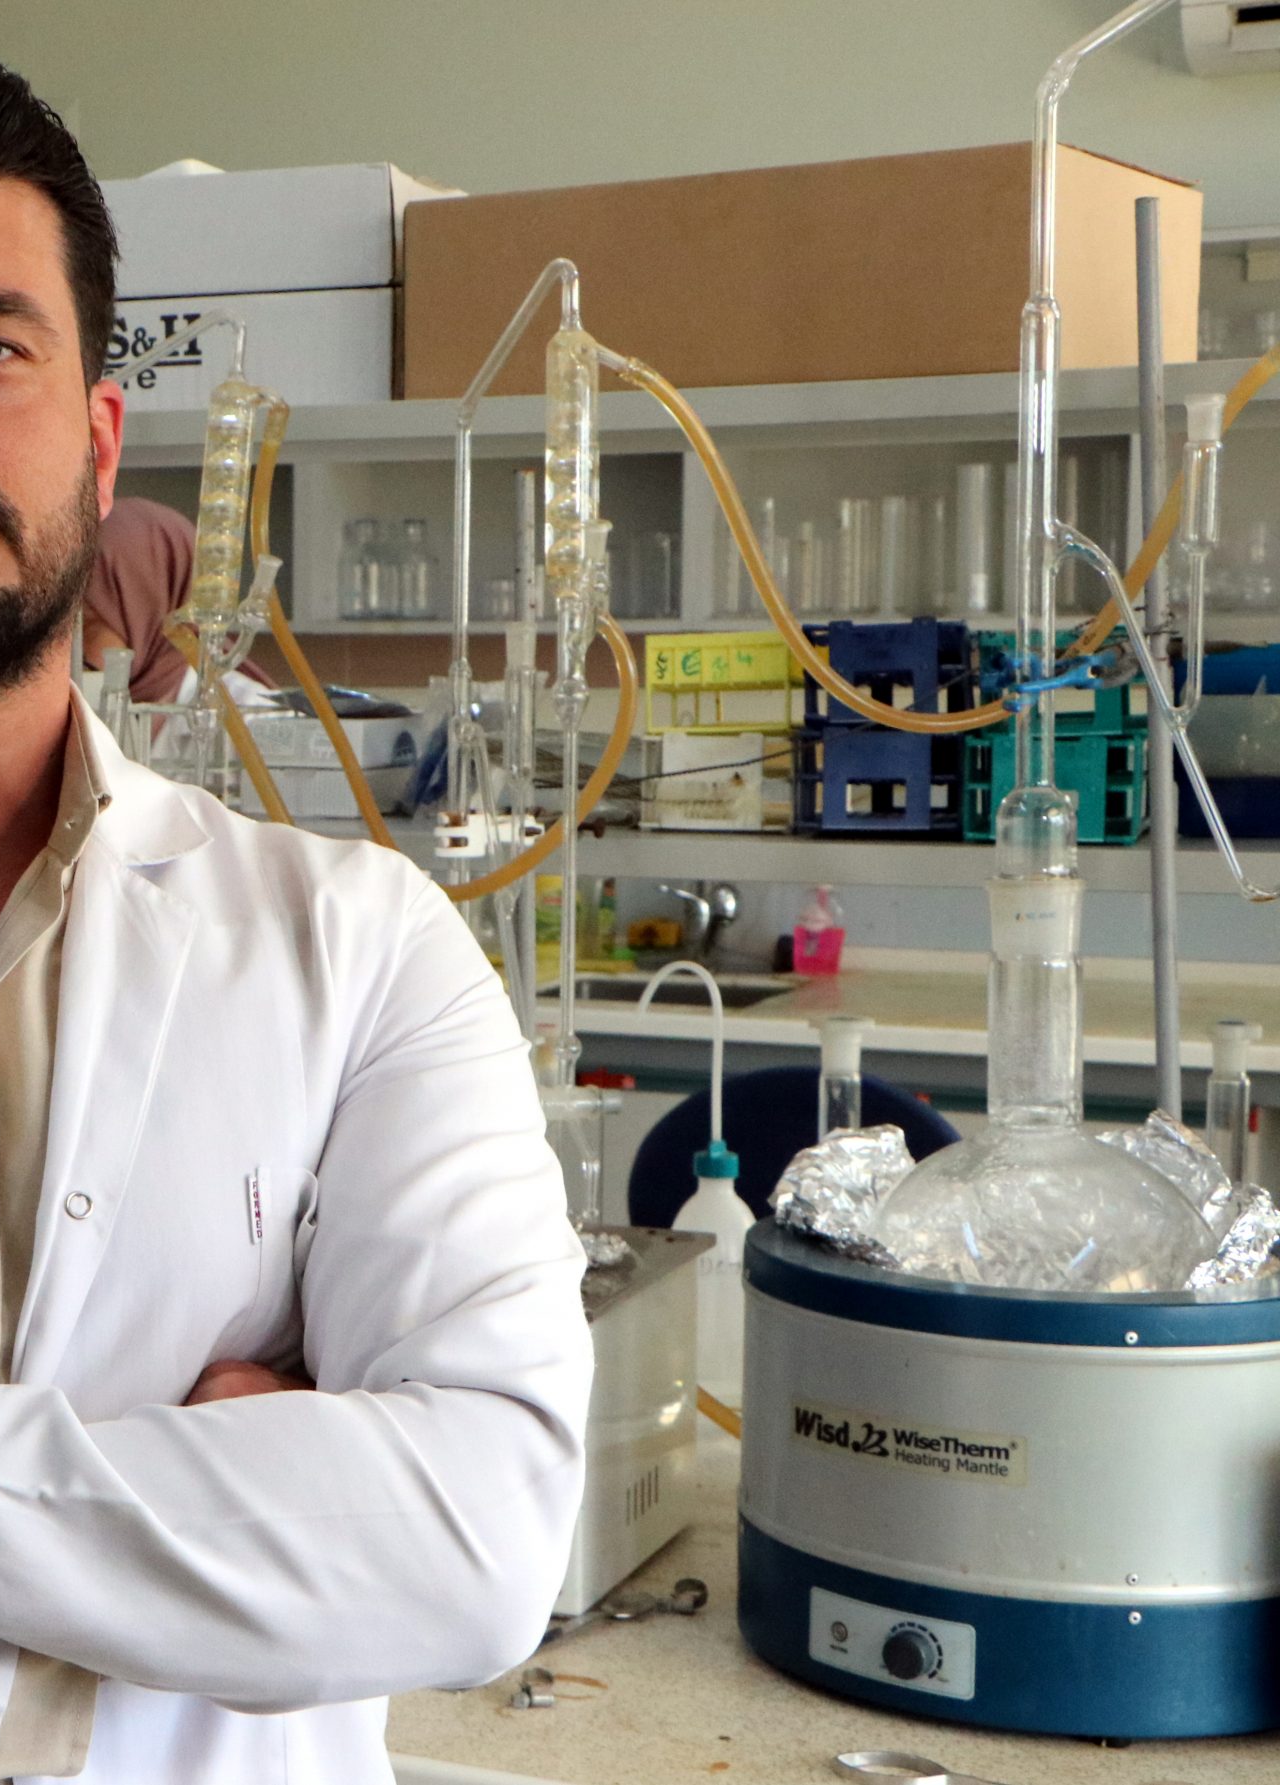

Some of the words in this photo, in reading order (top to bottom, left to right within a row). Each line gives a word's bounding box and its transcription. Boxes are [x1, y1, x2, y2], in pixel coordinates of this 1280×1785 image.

[795, 1407, 851, 1448] Wisd
[894, 1449, 950, 1473] Heating
[955, 1457, 1009, 1478] Mantle
